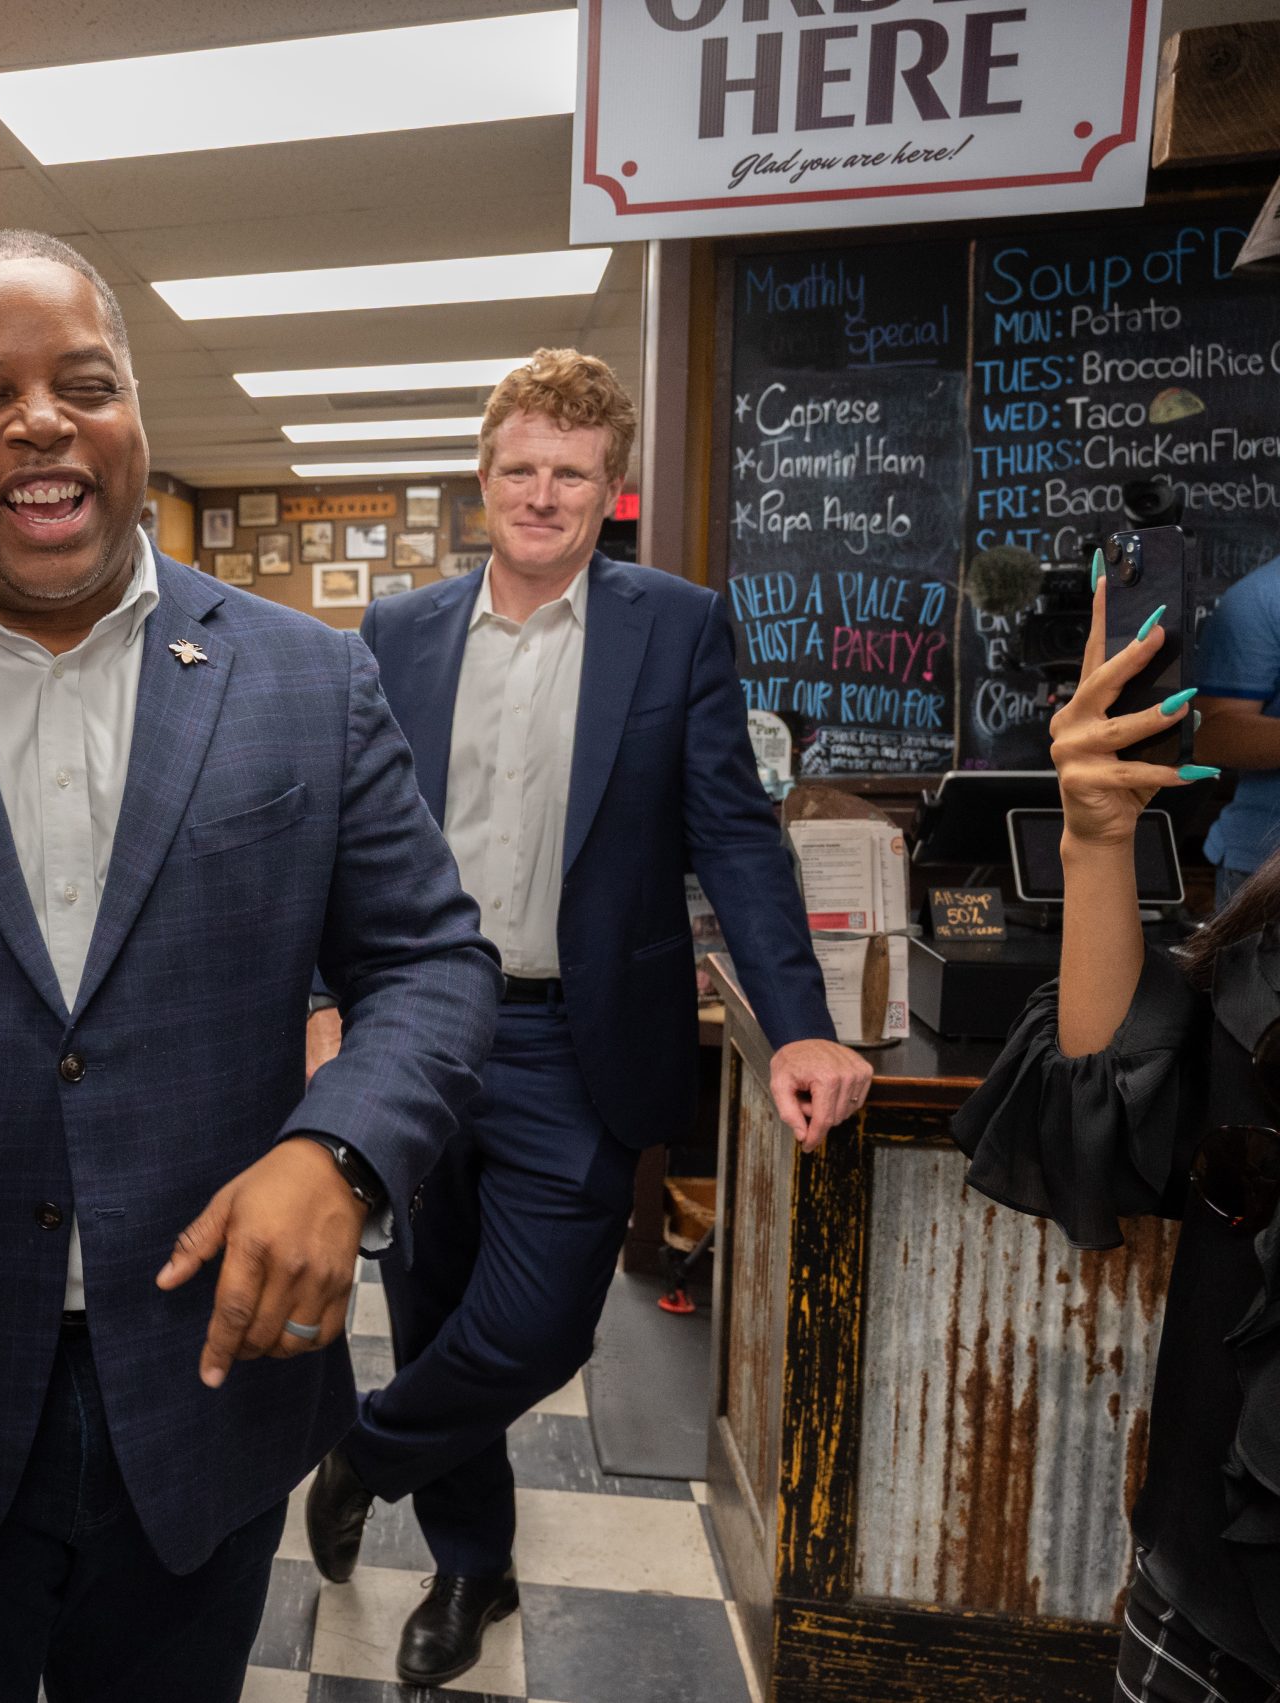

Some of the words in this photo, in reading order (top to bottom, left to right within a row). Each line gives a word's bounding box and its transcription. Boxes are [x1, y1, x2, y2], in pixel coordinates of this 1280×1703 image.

[698, 8, 1027, 139] HERE
[728, 148, 802, 190] Glad
[789, 156, 843, 184] you
[842, 150, 891, 169] are
[890, 134, 974, 165] here!
[746, 259, 865, 321] Monthly
[985, 248, 1132, 311] Soup
[1143, 227, 1205, 285] of
[844, 304, 949, 363] Special
[994, 308, 1063, 345] MON:
[1071, 298, 1182, 338] Potato
[975, 355, 1076, 395] TUES:
[1082, 344, 1202, 385] Broccoli
[1207, 343, 1265, 378] Rice
[756, 382, 881, 442] Caprese
[982, 402, 1062, 432] WED:
[1066, 396, 1146, 429] Taco
[756, 435, 860, 483] Jammin'
[866, 434, 926, 479] Ham
[973, 439, 1083, 480] THURS:
[1211, 427, 1280, 462] Flore
[759, 489, 812, 543] Papa
[822, 495, 912, 555] Angelo
[978, 485, 1040, 520] FRI:
[1045, 478, 1124, 517] Baco
[728, 571, 797, 622] NEED
[804, 572, 824, 615] A
[837, 571, 910, 627] PLACE
[919, 581, 947, 626] TO
[745, 617, 806, 665] HOST
[804, 620, 824, 661] A
[832, 625, 947, 683] PARTY?
[792, 680, 833, 721] OUR
[841, 682, 900, 726] ROOM
[903, 688, 945, 729] FOR
[946, 906, 984, 925] 50%
